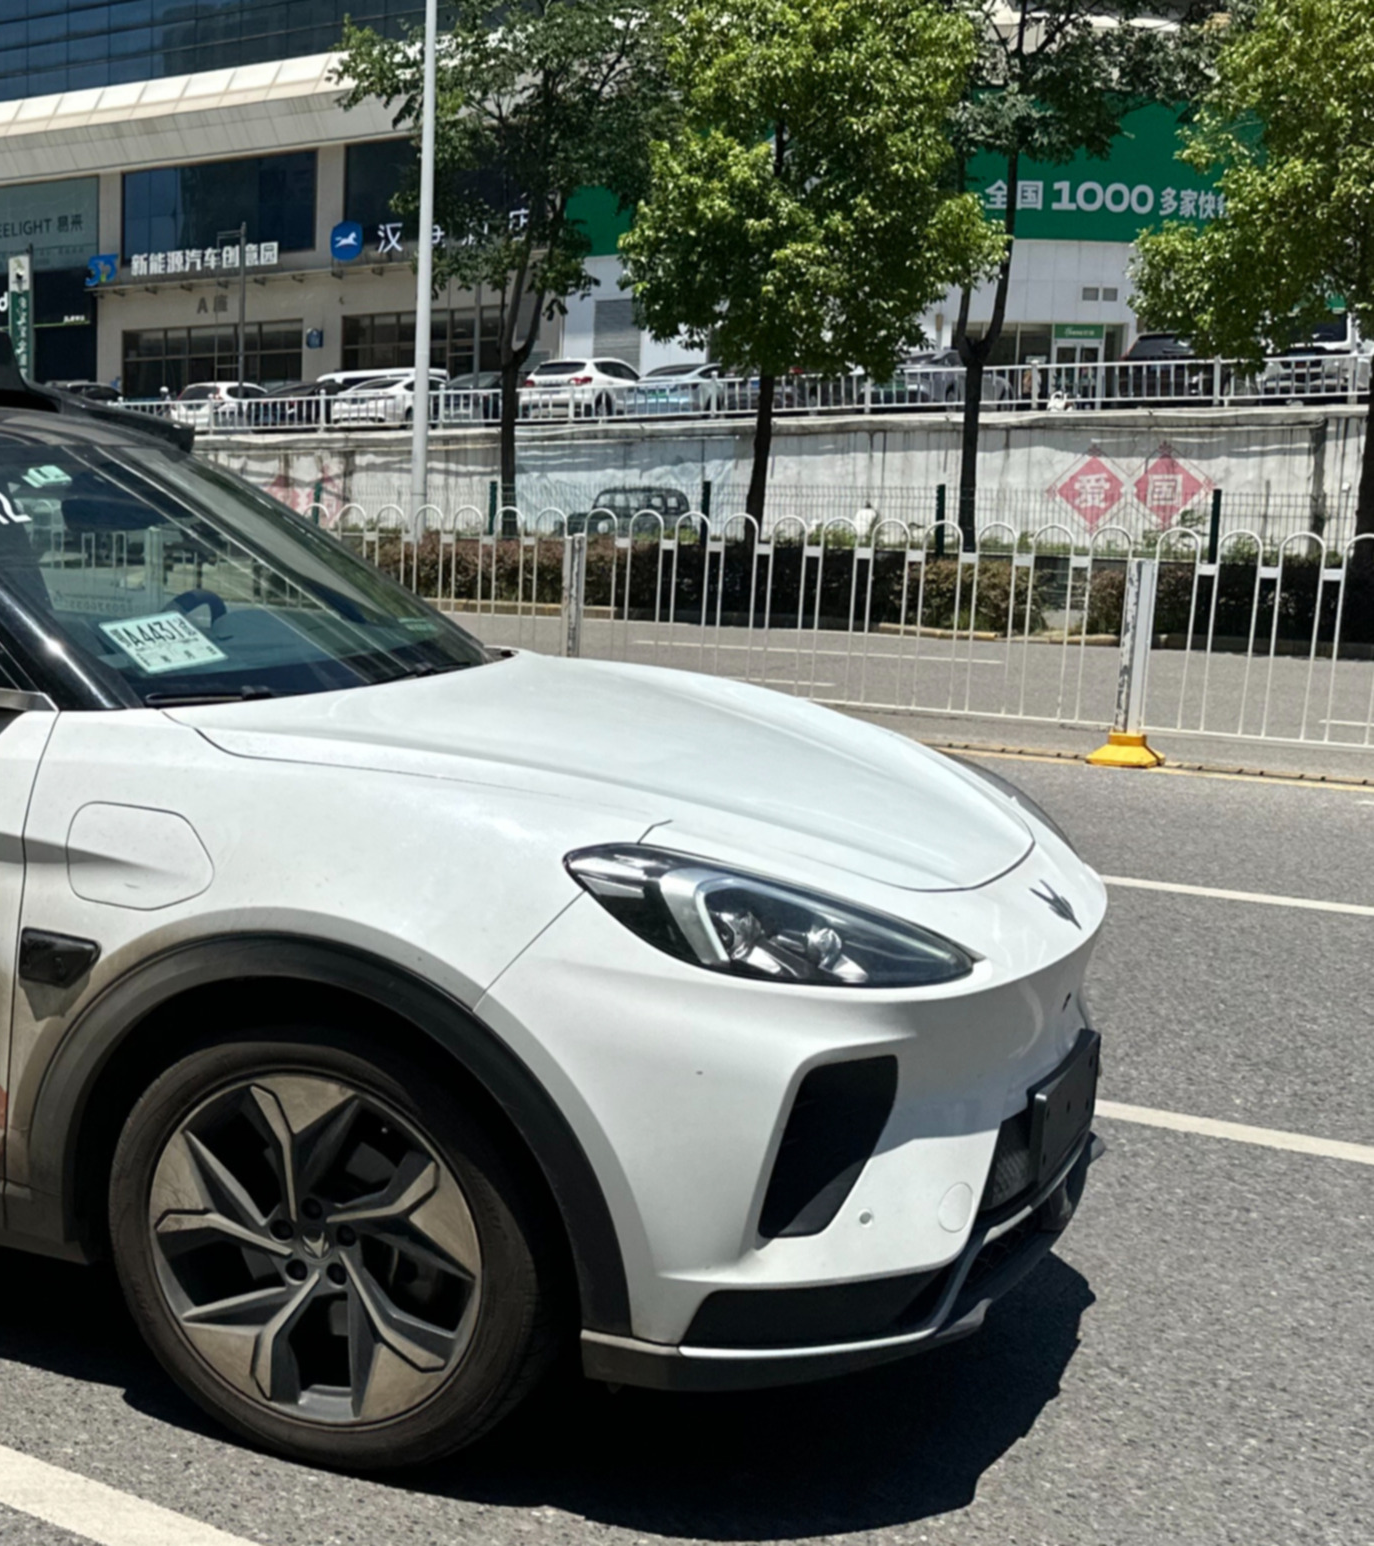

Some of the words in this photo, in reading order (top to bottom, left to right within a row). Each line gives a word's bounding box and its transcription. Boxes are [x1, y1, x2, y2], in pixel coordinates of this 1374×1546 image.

[984, 180, 1044, 210] 全国
[1051, 181, 1154, 214] 1000
[57, 213, 83, 233] 易来
[130, 241, 279, 277] 新能源汽车创意园
